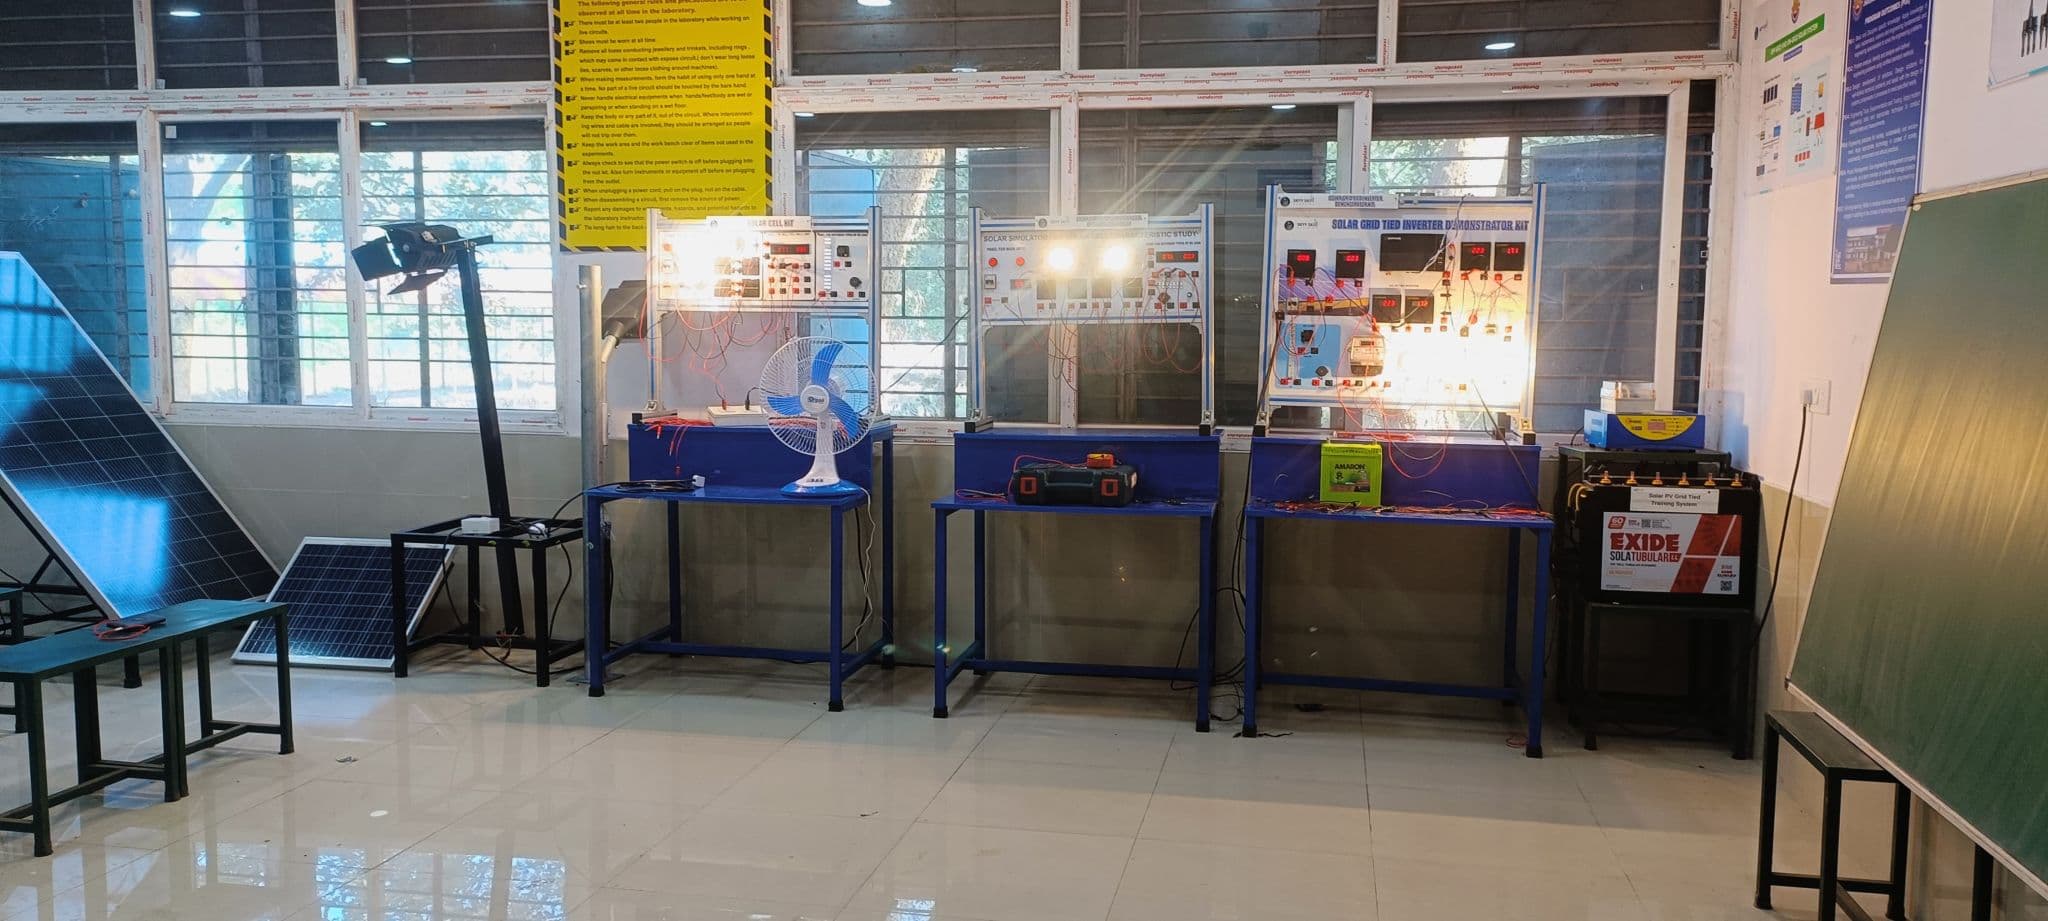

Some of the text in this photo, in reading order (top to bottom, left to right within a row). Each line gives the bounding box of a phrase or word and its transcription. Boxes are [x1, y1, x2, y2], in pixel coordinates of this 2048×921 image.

[1332, 219, 1359, 230] SOLAR
[1360, 219, 1380, 230] GRID
[1382, 219, 1400, 230] TIED
[1402, 219, 1443, 231] INVERTER
[1515, 219, 1529, 231] KIT
[1610, 532, 1680, 552] EXIDE
[1610, 550, 1669, 562] SOLATUBULAR
